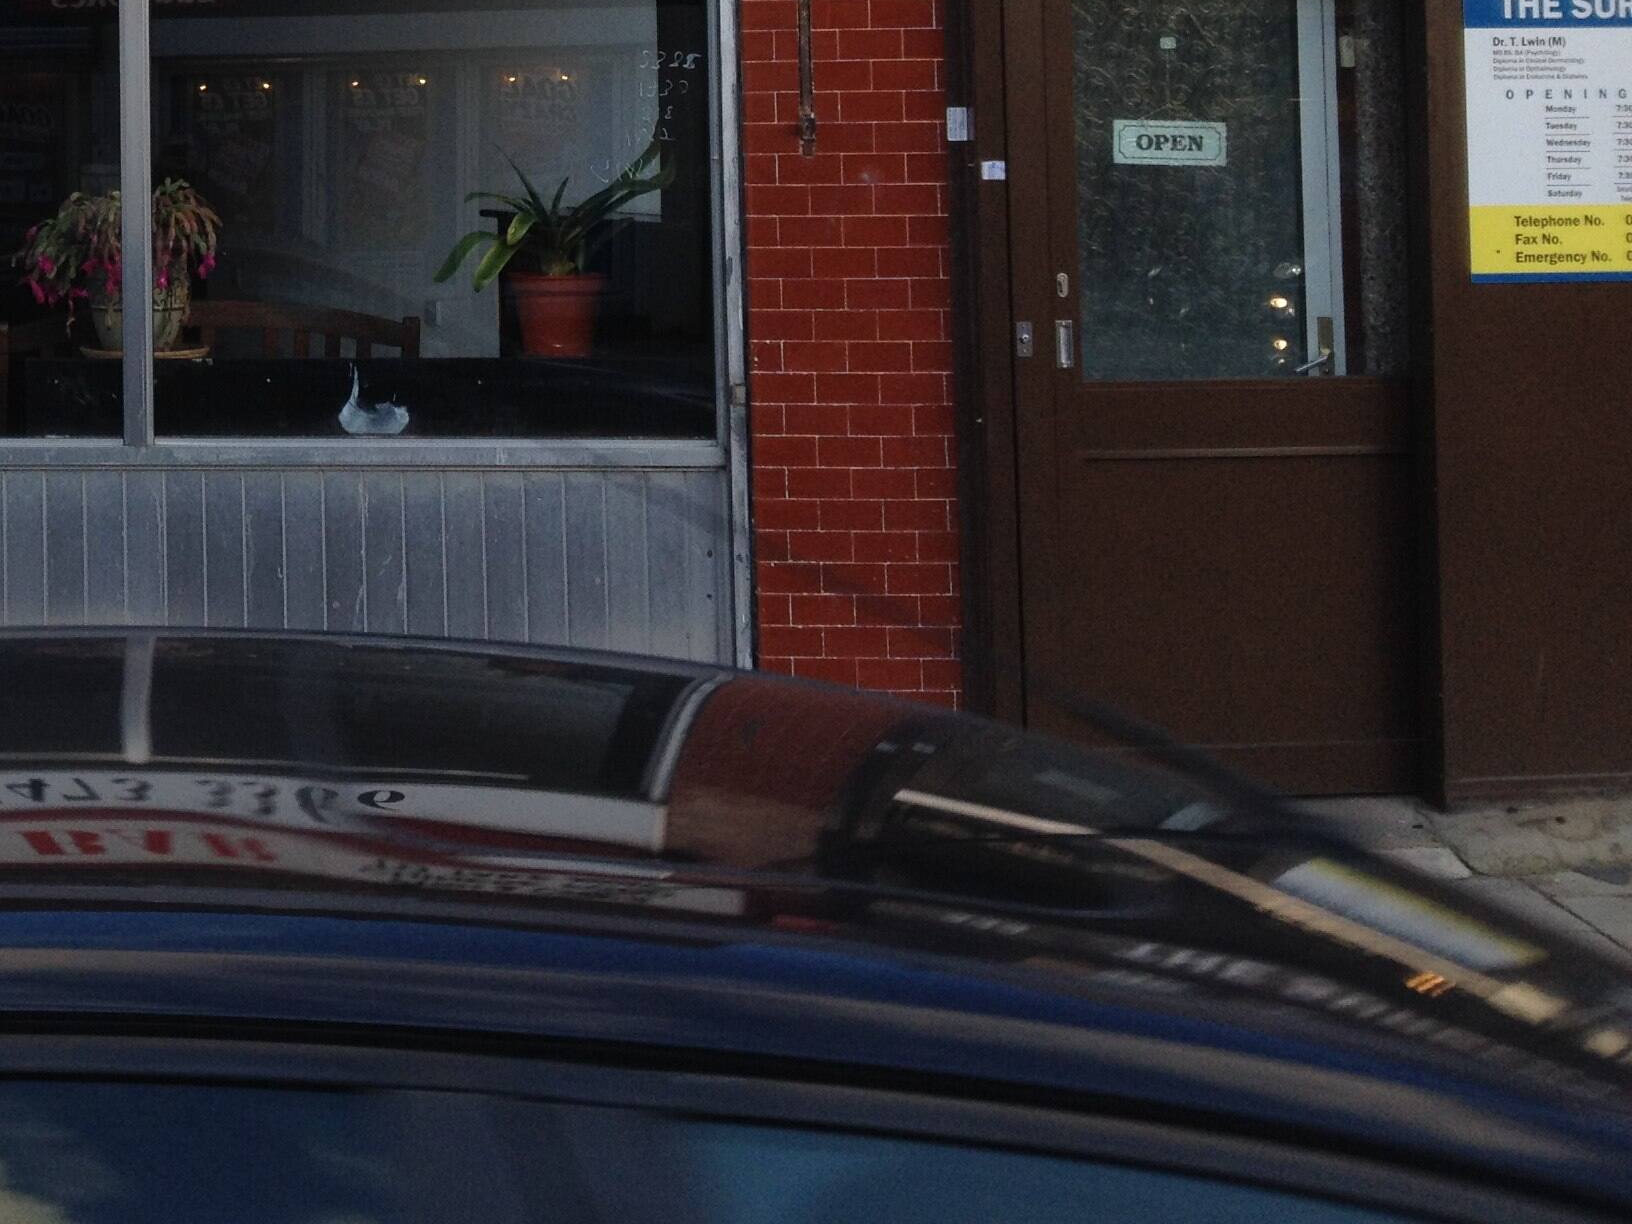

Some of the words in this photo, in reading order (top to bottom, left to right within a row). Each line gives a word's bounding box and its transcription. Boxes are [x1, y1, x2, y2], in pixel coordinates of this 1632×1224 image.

[1492, 36, 1507, 47] Dr.
[1521, 36, 1546, 47] Lwin
[1548, 36, 1566, 48] (M)
[1505, 88, 1628, 100] OPENING
[1545, 105, 1576, 114] Monday
[1545, 122, 1577, 131] Tuesday
[1135, 134, 1204, 151] OPEN
[1546, 139, 1591, 148] Wednesday
[1547, 156, 1582, 165] Thursday
[1548, 172, 1571, 182] Friday
[1548, 189, 1583, 198] Saturday
[1514, 215, 1581, 229] Telephone
[1584, 214, 1605, 226] No.
[1515, 233, 1538, 245] Fax
[1542, 233, 1563, 245] No.
[1516, 251, 1587, 265] Emergency
[1591, 250, 1612, 263] No.
